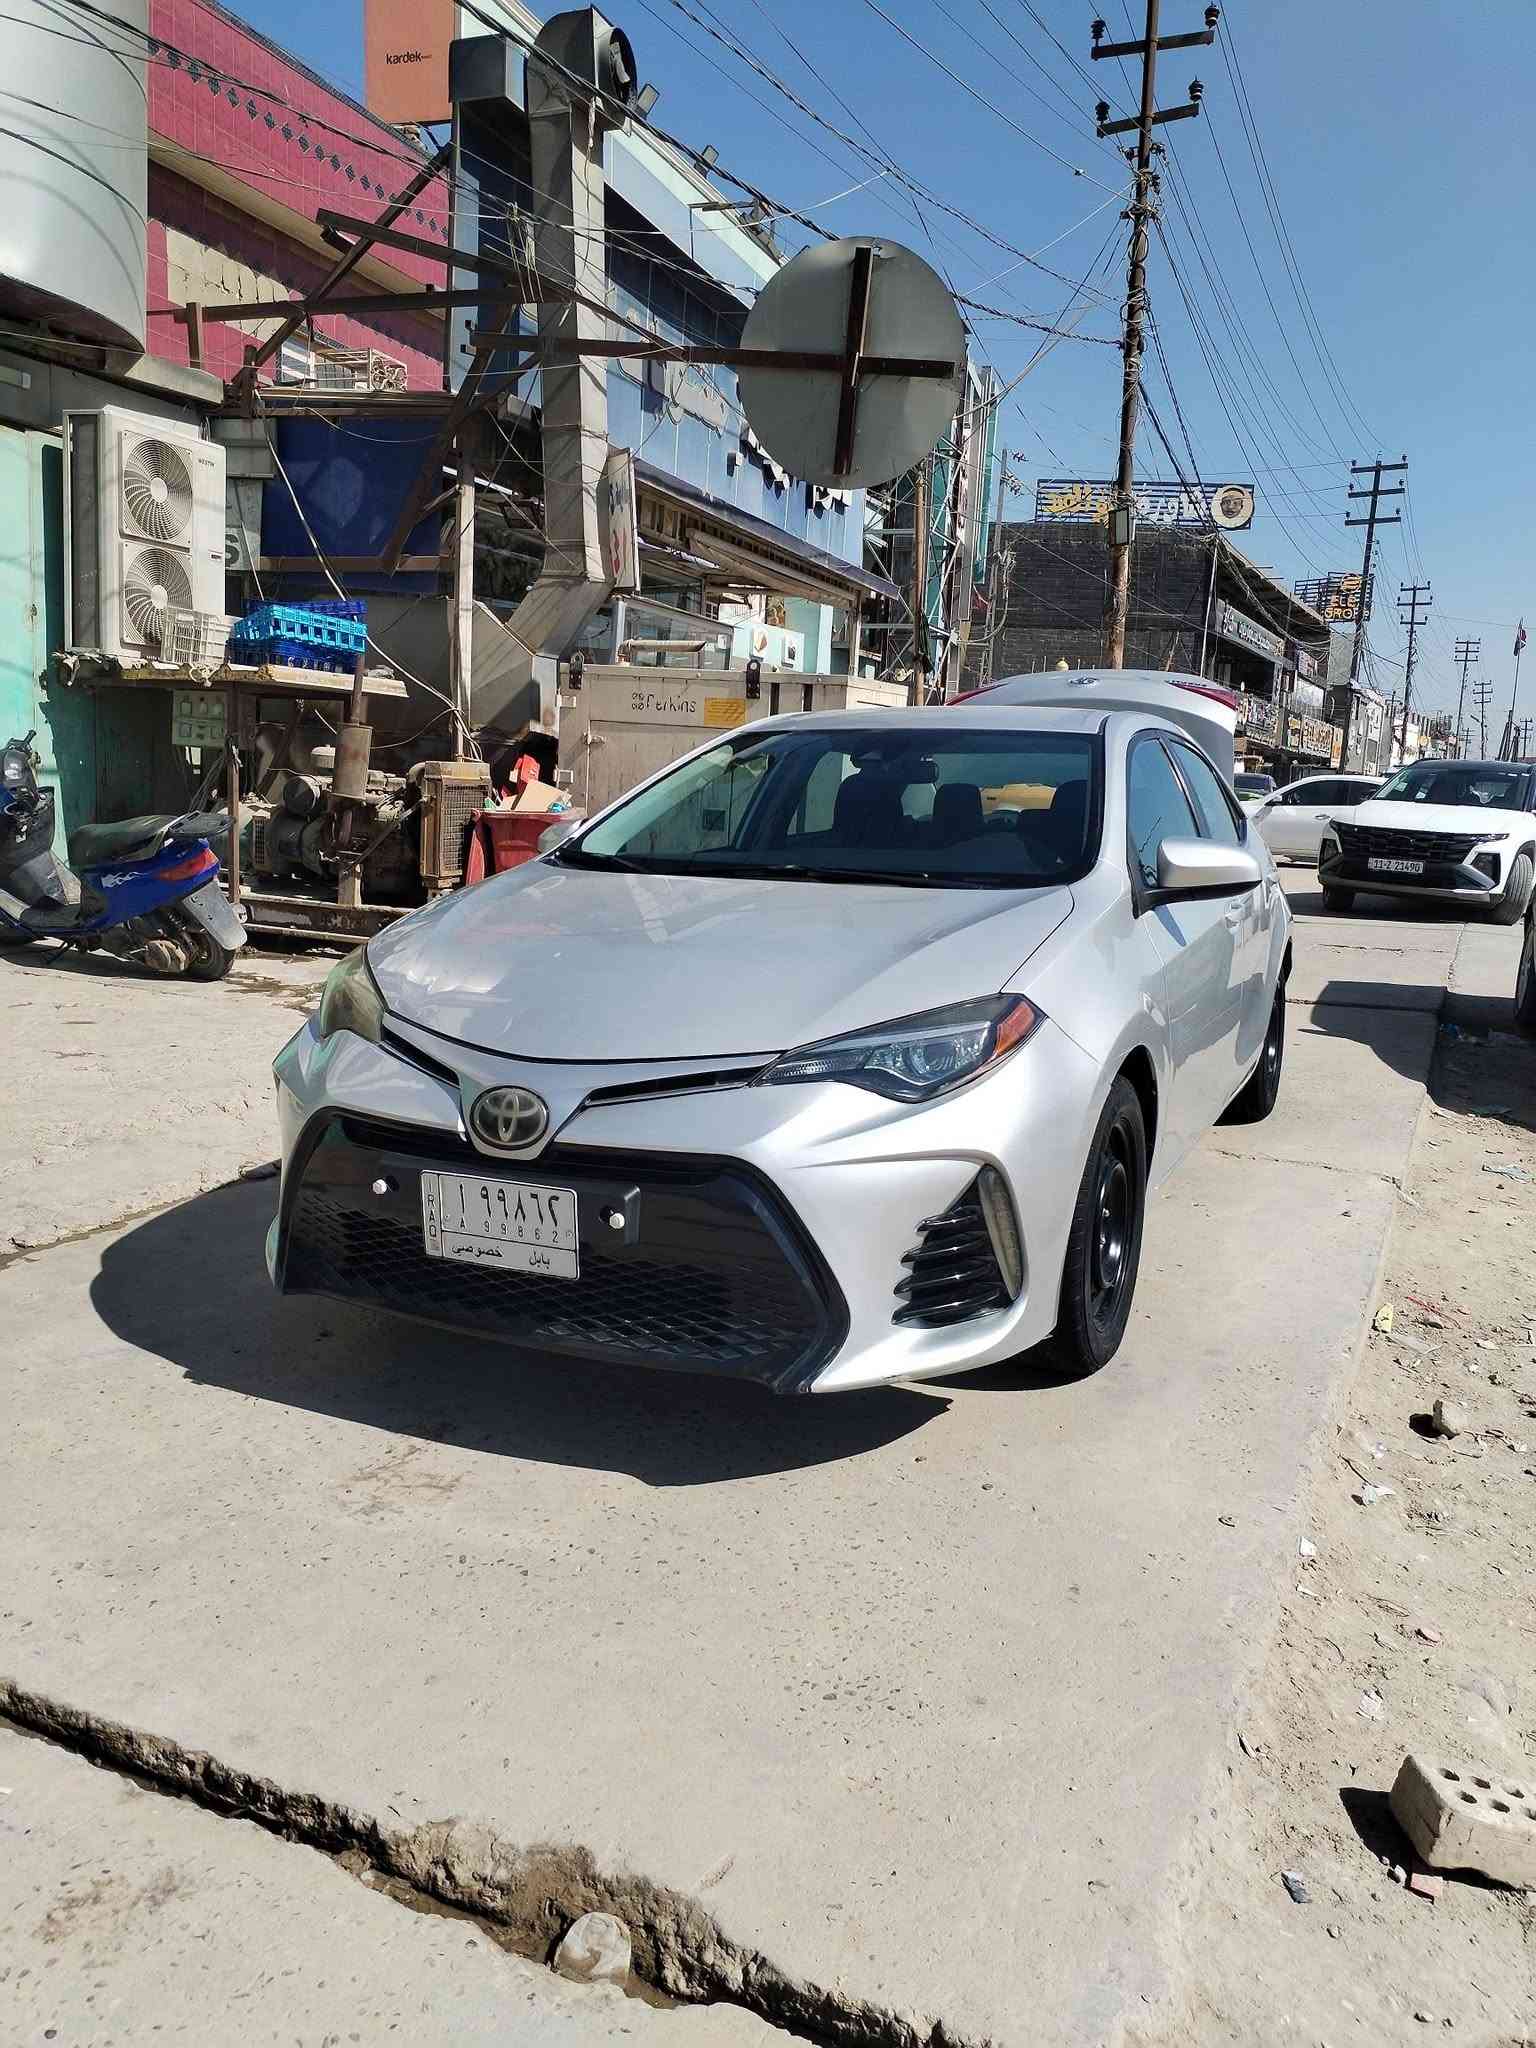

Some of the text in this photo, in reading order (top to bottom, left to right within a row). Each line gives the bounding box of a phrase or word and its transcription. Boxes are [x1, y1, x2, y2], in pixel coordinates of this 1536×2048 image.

[385, 51, 422, 65] kardek
[451, 1243, 551, 1270] بابل خصوصي
